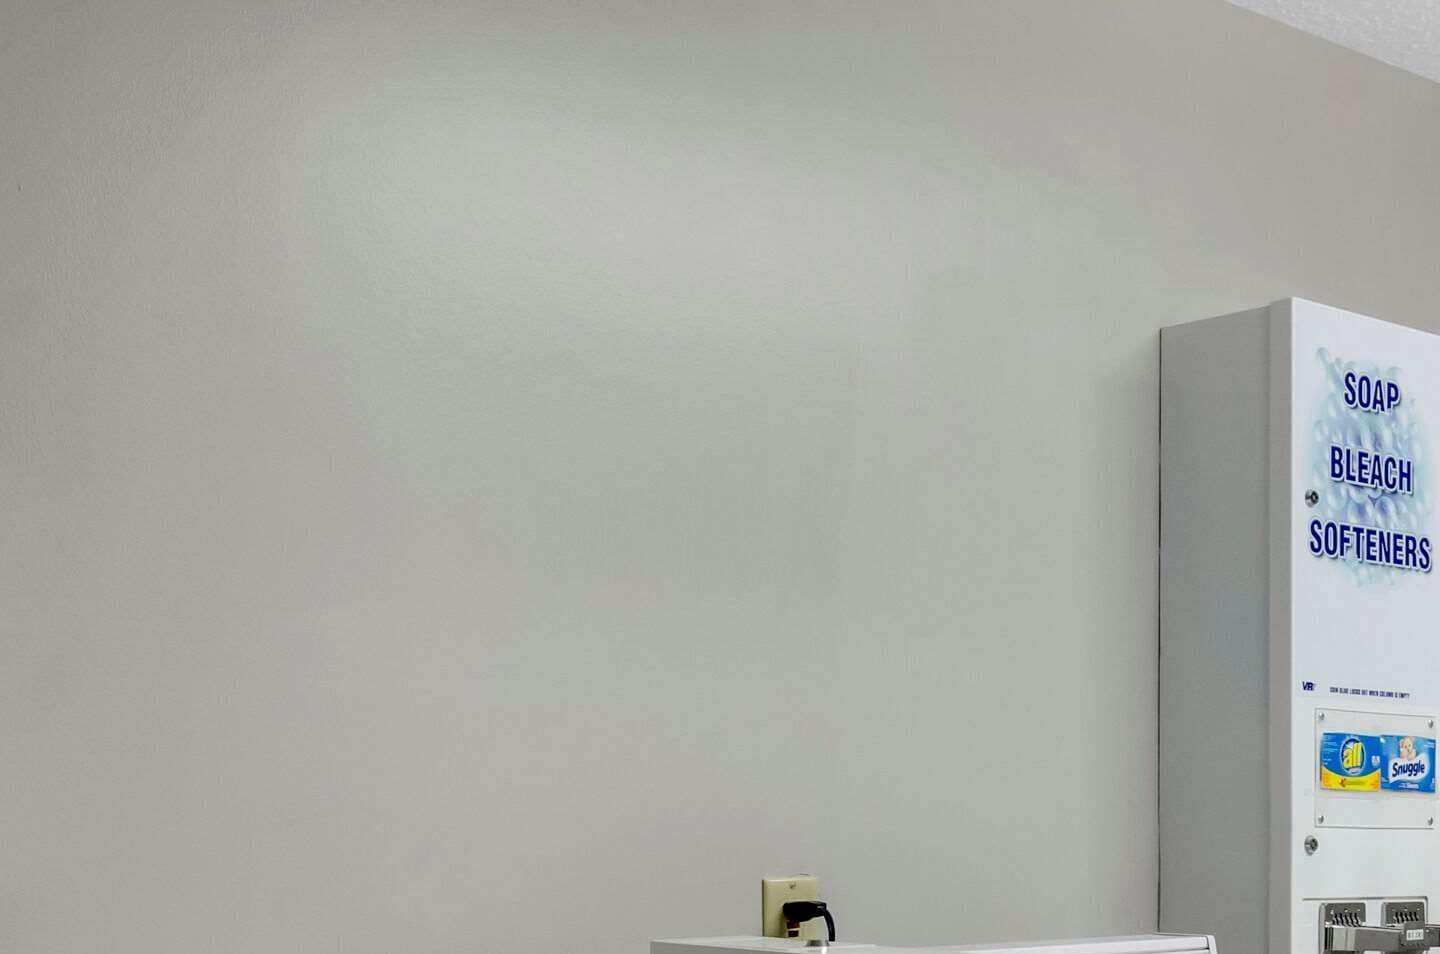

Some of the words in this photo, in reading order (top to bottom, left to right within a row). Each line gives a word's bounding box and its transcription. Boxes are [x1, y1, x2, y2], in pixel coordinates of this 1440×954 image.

[1343, 371, 1400, 412] SOAP
[1329, 444, 1412, 492] BLEACH
[1309, 518, 1431, 570] SOFTENERS
[1343, 742, 1363, 769] all
[1391, 759, 1425, 778] Snuggle
